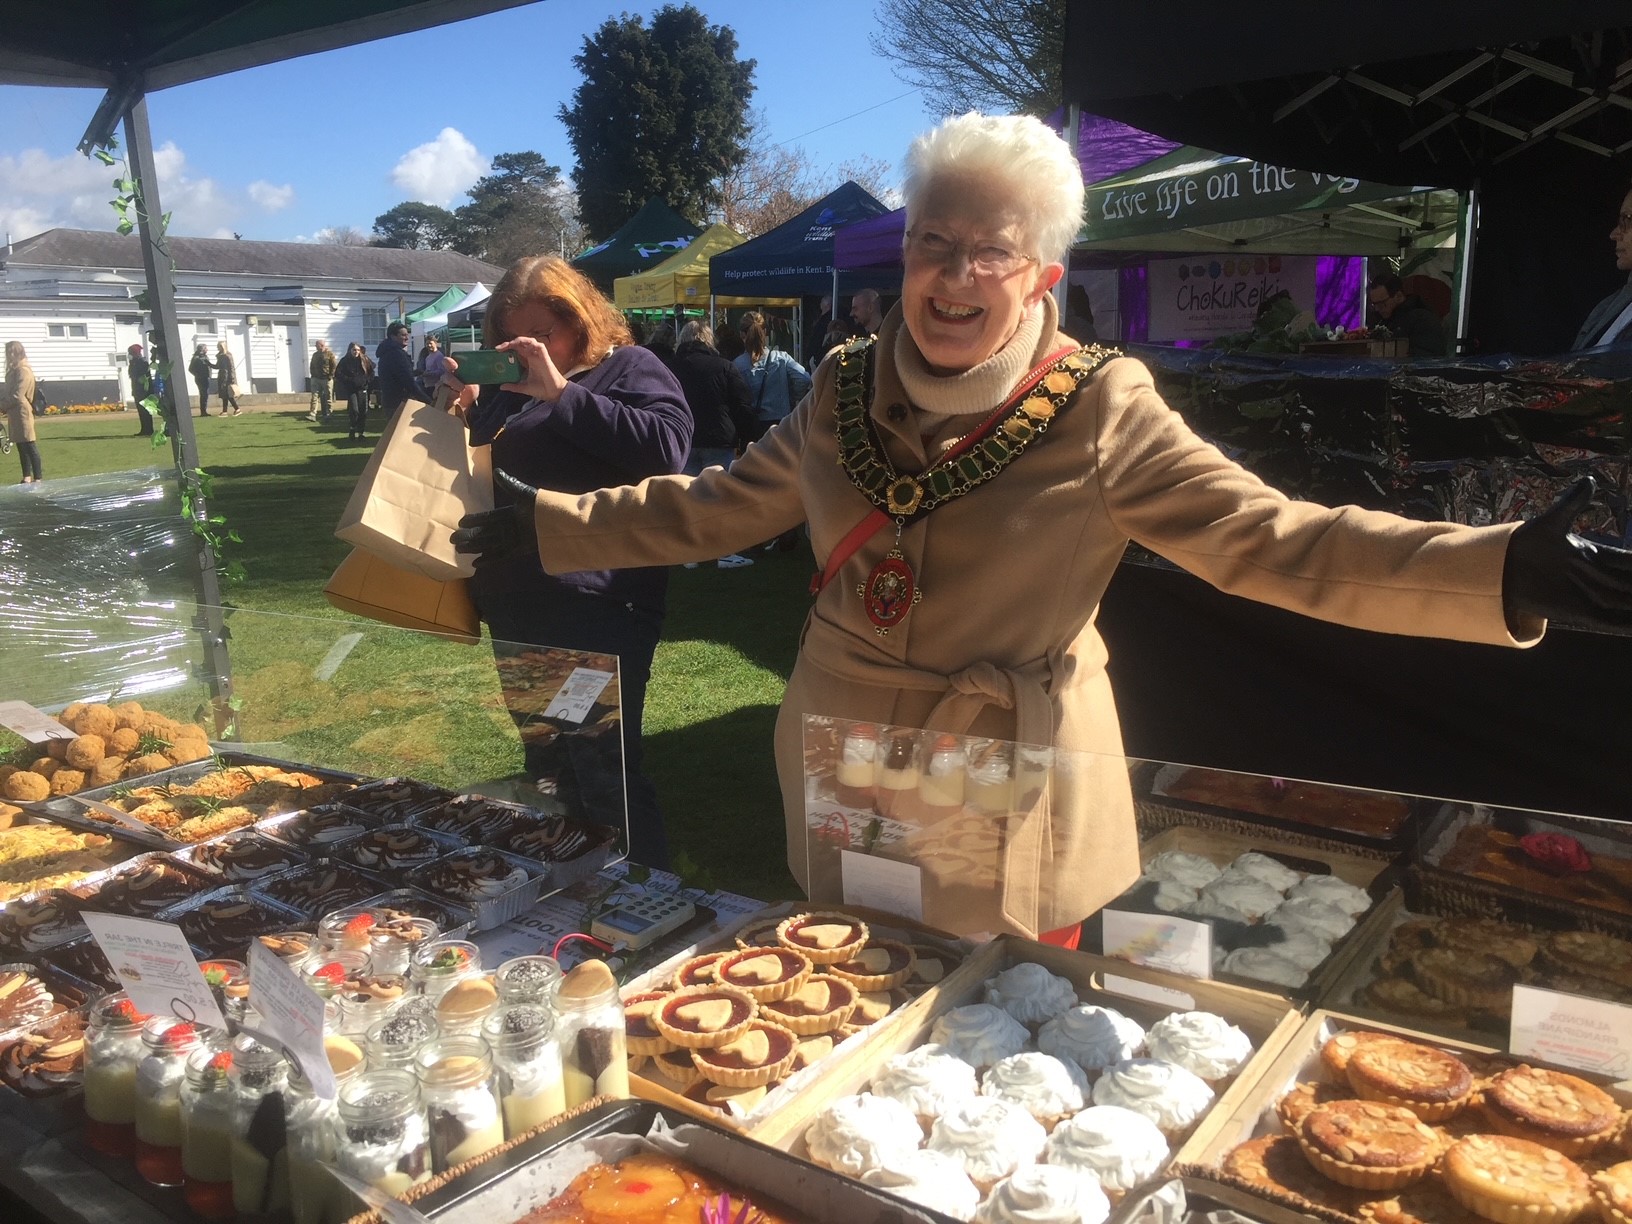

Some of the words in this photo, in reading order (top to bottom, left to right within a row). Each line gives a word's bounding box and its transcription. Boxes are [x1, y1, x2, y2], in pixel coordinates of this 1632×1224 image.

[1101, 190, 1148, 220] Live
[1156, 176, 1198, 220] life
[1206, 171, 1240, 200] on
[1248, 161, 1297, 195] the
[724, 270, 742, 279] Help
[742, 270, 767, 279] protect
[768, 266, 796, 276] wildlife
[796, 265, 804, 273] in
